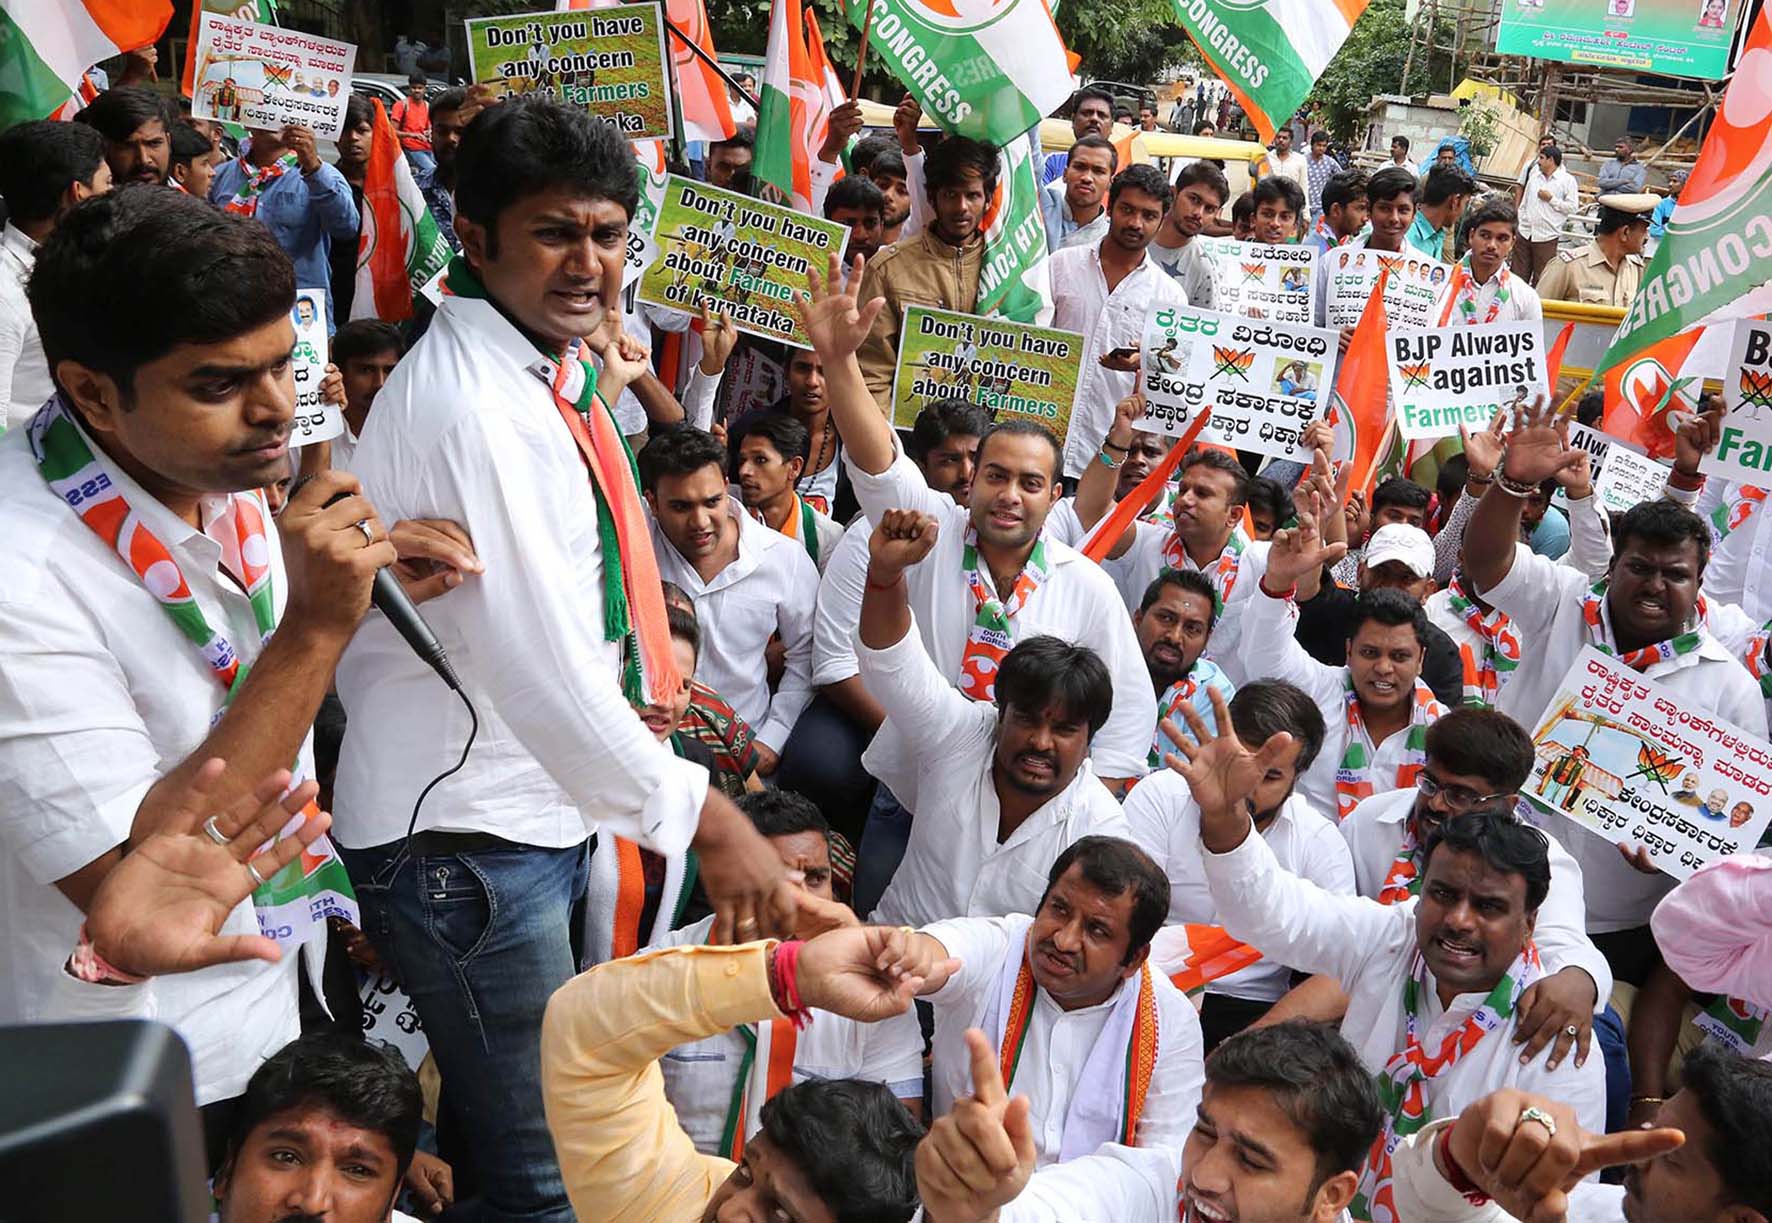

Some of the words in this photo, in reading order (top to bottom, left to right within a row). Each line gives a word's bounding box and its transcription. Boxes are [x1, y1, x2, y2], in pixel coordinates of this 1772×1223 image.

[487, 23, 542, 47] Don't
[549, 23, 586, 45] you
[592, 17, 643, 37] have
[504, 59, 541, 79] any
[547, 51, 633, 73] concern
[561, 82, 650, 105] Farmers
[680, 188, 736, 220] Don't
[739, 208, 776, 232] you
[781, 218, 829, 248] have
[684, 226, 723, 251] any
[727, 238, 808, 275] concern
[665, 252, 725, 281] about
[728, 267, 812, 304] Farmes
[665, 284, 688, 303] of
[692, 288, 795, 334] karnataka
[921, 316, 974, 343] Don't
[979, 329, 1014, 349] you
[1021, 333, 1069, 358] have
[1155, 308, 1220, 337] ರೈತರ
[1232, 323, 1327, 358] ವಿರೋಧಿ
[1395, 335, 1442, 362] BJP
[1451, 331, 1535, 358] Always
[928, 352, 966, 373] any
[970, 359, 1051, 386] concern
[1433, 357, 1537, 394] against
[912, 379, 970, 401] about
[976, 387, 1057, 418] Farmers
[1147, 372, 1206, 406] ಕೇಂದ್ರ
[1216, 387, 1317, 431] ಸರ್ಕಾರಕ್ಕೆ
[1404, 403, 1500, 429] Farmers
[1570, 430, 1609, 458] Alw
[1580, 684, 1624, 717] ರೈತರ
[1627, 710, 1705, 770] ಸಾಲಮನ್ನಾ
[1713, 758, 1772, 797] ಮಾಡದ
[1632, 821, 1678, 857] ಧಿಕ್ಕಾರ
